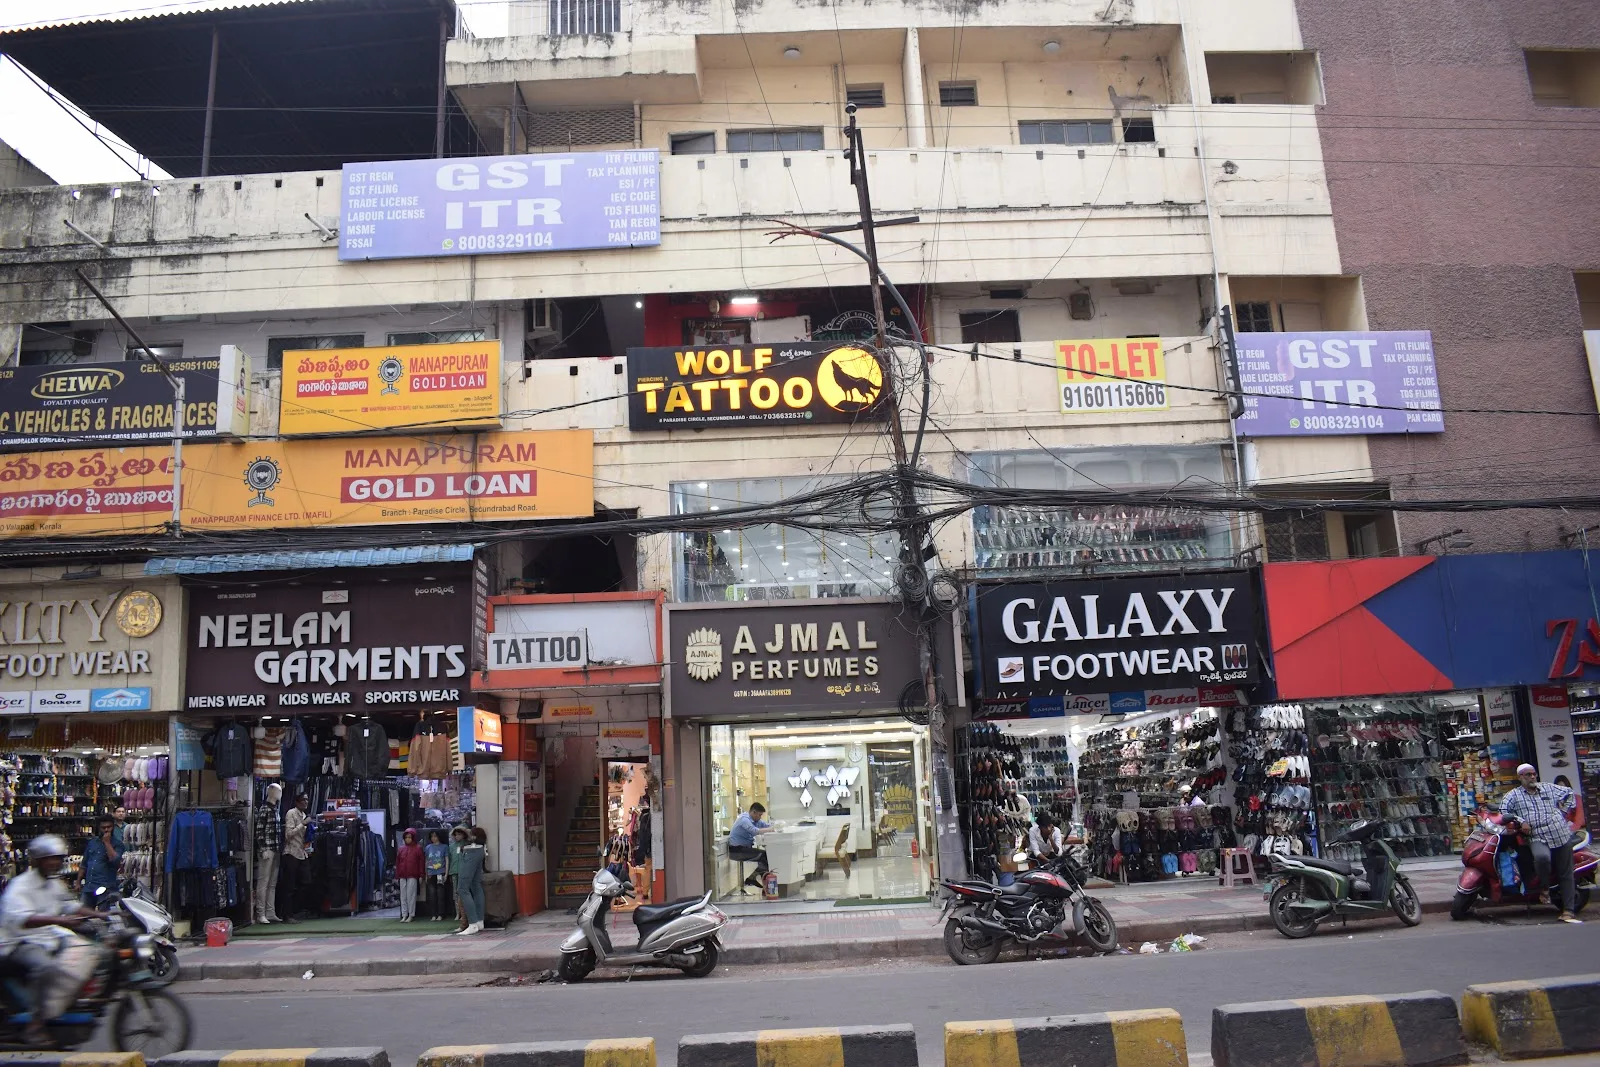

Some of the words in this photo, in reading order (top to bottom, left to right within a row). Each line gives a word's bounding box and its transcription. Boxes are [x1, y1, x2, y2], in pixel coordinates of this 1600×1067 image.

[606, 154, 620, 163] ITR
[624, 152, 655, 162] FILING
[350, 173, 367, 182] GST
[369, 172, 394, 181] REGN
[436, 158, 575, 191] GST
[587, 168, 604, 177] TAX
[607, 165, 655, 176] PLANNING
[349, 185, 366, 195] GST
[368, 184, 398, 194] FILING
[619, 179, 634, 189] ESI
[643, 178, 656, 188] PF
[348, 199, 378, 208] TRADE
[380, 196, 418, 207] LICENSE
[611, 192, 626, 202] IEC
[630, 191, 656, 201] CODE
[347, 211, 384, 222] LABOUR
[387, 209, 425, 220] LICENSE
[445, 198, 563, 229] ITR
[604, 206, 622, 216] TDS
[625, 204, 656, 214] FILING
[609, 219, 627, 229] TAN
[631, 218, 656, 227] REGN
[347, 225, 376, 235] MSME
[458, 232, 552, 250] 8008329104
[608, 232, 627, 242] PAN
[631, 231, 657, 240] CARD
[346, 238, 373, 248] FSSAI
[1394, 342, 1406, 351] ITR
[1408, 342, 1430, 350] FILING
[1246, 350, 1264, 358] REGN
[1289, 340, 1377, 369] GST
[1383, 354, 1396, 362] TAX
[1397, 353, 1431, 362] PLANNING
[409, 354, 488, 373] MANAPPURAM
[675, 348, 773, 376] WOLF
[1060, 343, 1158, 380] TO-LET
[1248, 362, 1270, 370] FILING
[1407, 366, 1418, 374] ESI
[40, 375, 112, 393] HEIWA
[412, 376, 447, 389] GOLD
[451, 374, 485, 387] LOAN
[1258, 374, 1286, 382] LICENSE
[1403, 378, 1415, 386] IEC
[1417, 377, 1435, 386] CODE
[637, 377, 813, 413] TATTOO
[1265, 385, 1294, 394] LICENSE
[1300, 380, 1378, 409] ITR
[1400, 390, 1413, 398] TDS
[1415, 389, 1437, 398] FILING
[1063, 384, 1165, 408] 9160115666
[1243, 398, 1258, 407] SME
[1405, 401, 1418, 409] TAN
[15, 408, 91, 433] VEHICLES
[95, 407, 106, 431] &
[1303, 415, 1384, 429] 8008329104
[1407, 414, 1420, 422] PAN
[1422, 413, 1441, 422] CARD
[344, 443, 536, 469] MANAPPURAM
[348, 477, 436, 500] GOLD
[446, 474, 531, 496] LOAN
[381, 508, 407, 517] Branch
[412, 506, 443, 515] Paradise
[444, 505, 468, 515] Circle,
[518, 503, 538, 512] Road.
[190, 515, 246, 525] MANAPPURAM
[248, 513, 282, 523] FINANCE
[285, 512, 300, 520] LTD.
[302, 510, 333, 520] (MAFIL)
[6, 522, 36, 531] Valapad,
[1002, 588, 1235, 645] GALAXY
[199, 610, 350, 648] NEELAM
[732, 620, 878, 655] AJMAL
[493, 636, 581, 664] TATTOO
[69, 650, 151, 677] WEAR
[254, 644, 466, 687] GARMENTS
[731, 655, 879, 681] PERFUMES
[1032, 647, 1215, 681] FOOTWEAR
[39, 698, 82, 706] Bonkerz
[95, 696, 142, 708] asian
[188, 695, 225, 708] MENS
[227, 694, 266, 707] WEAR
[279, 692, 309, 706] KIDS
[312, 692, 350, 705] WEAR
[365, 691, 418, 704] SPORTS
[419, 689, 460, 702] WEAR
[1066, 699, 1108, 710] Lancer
[1146, 694, 1198, 706] Bata
